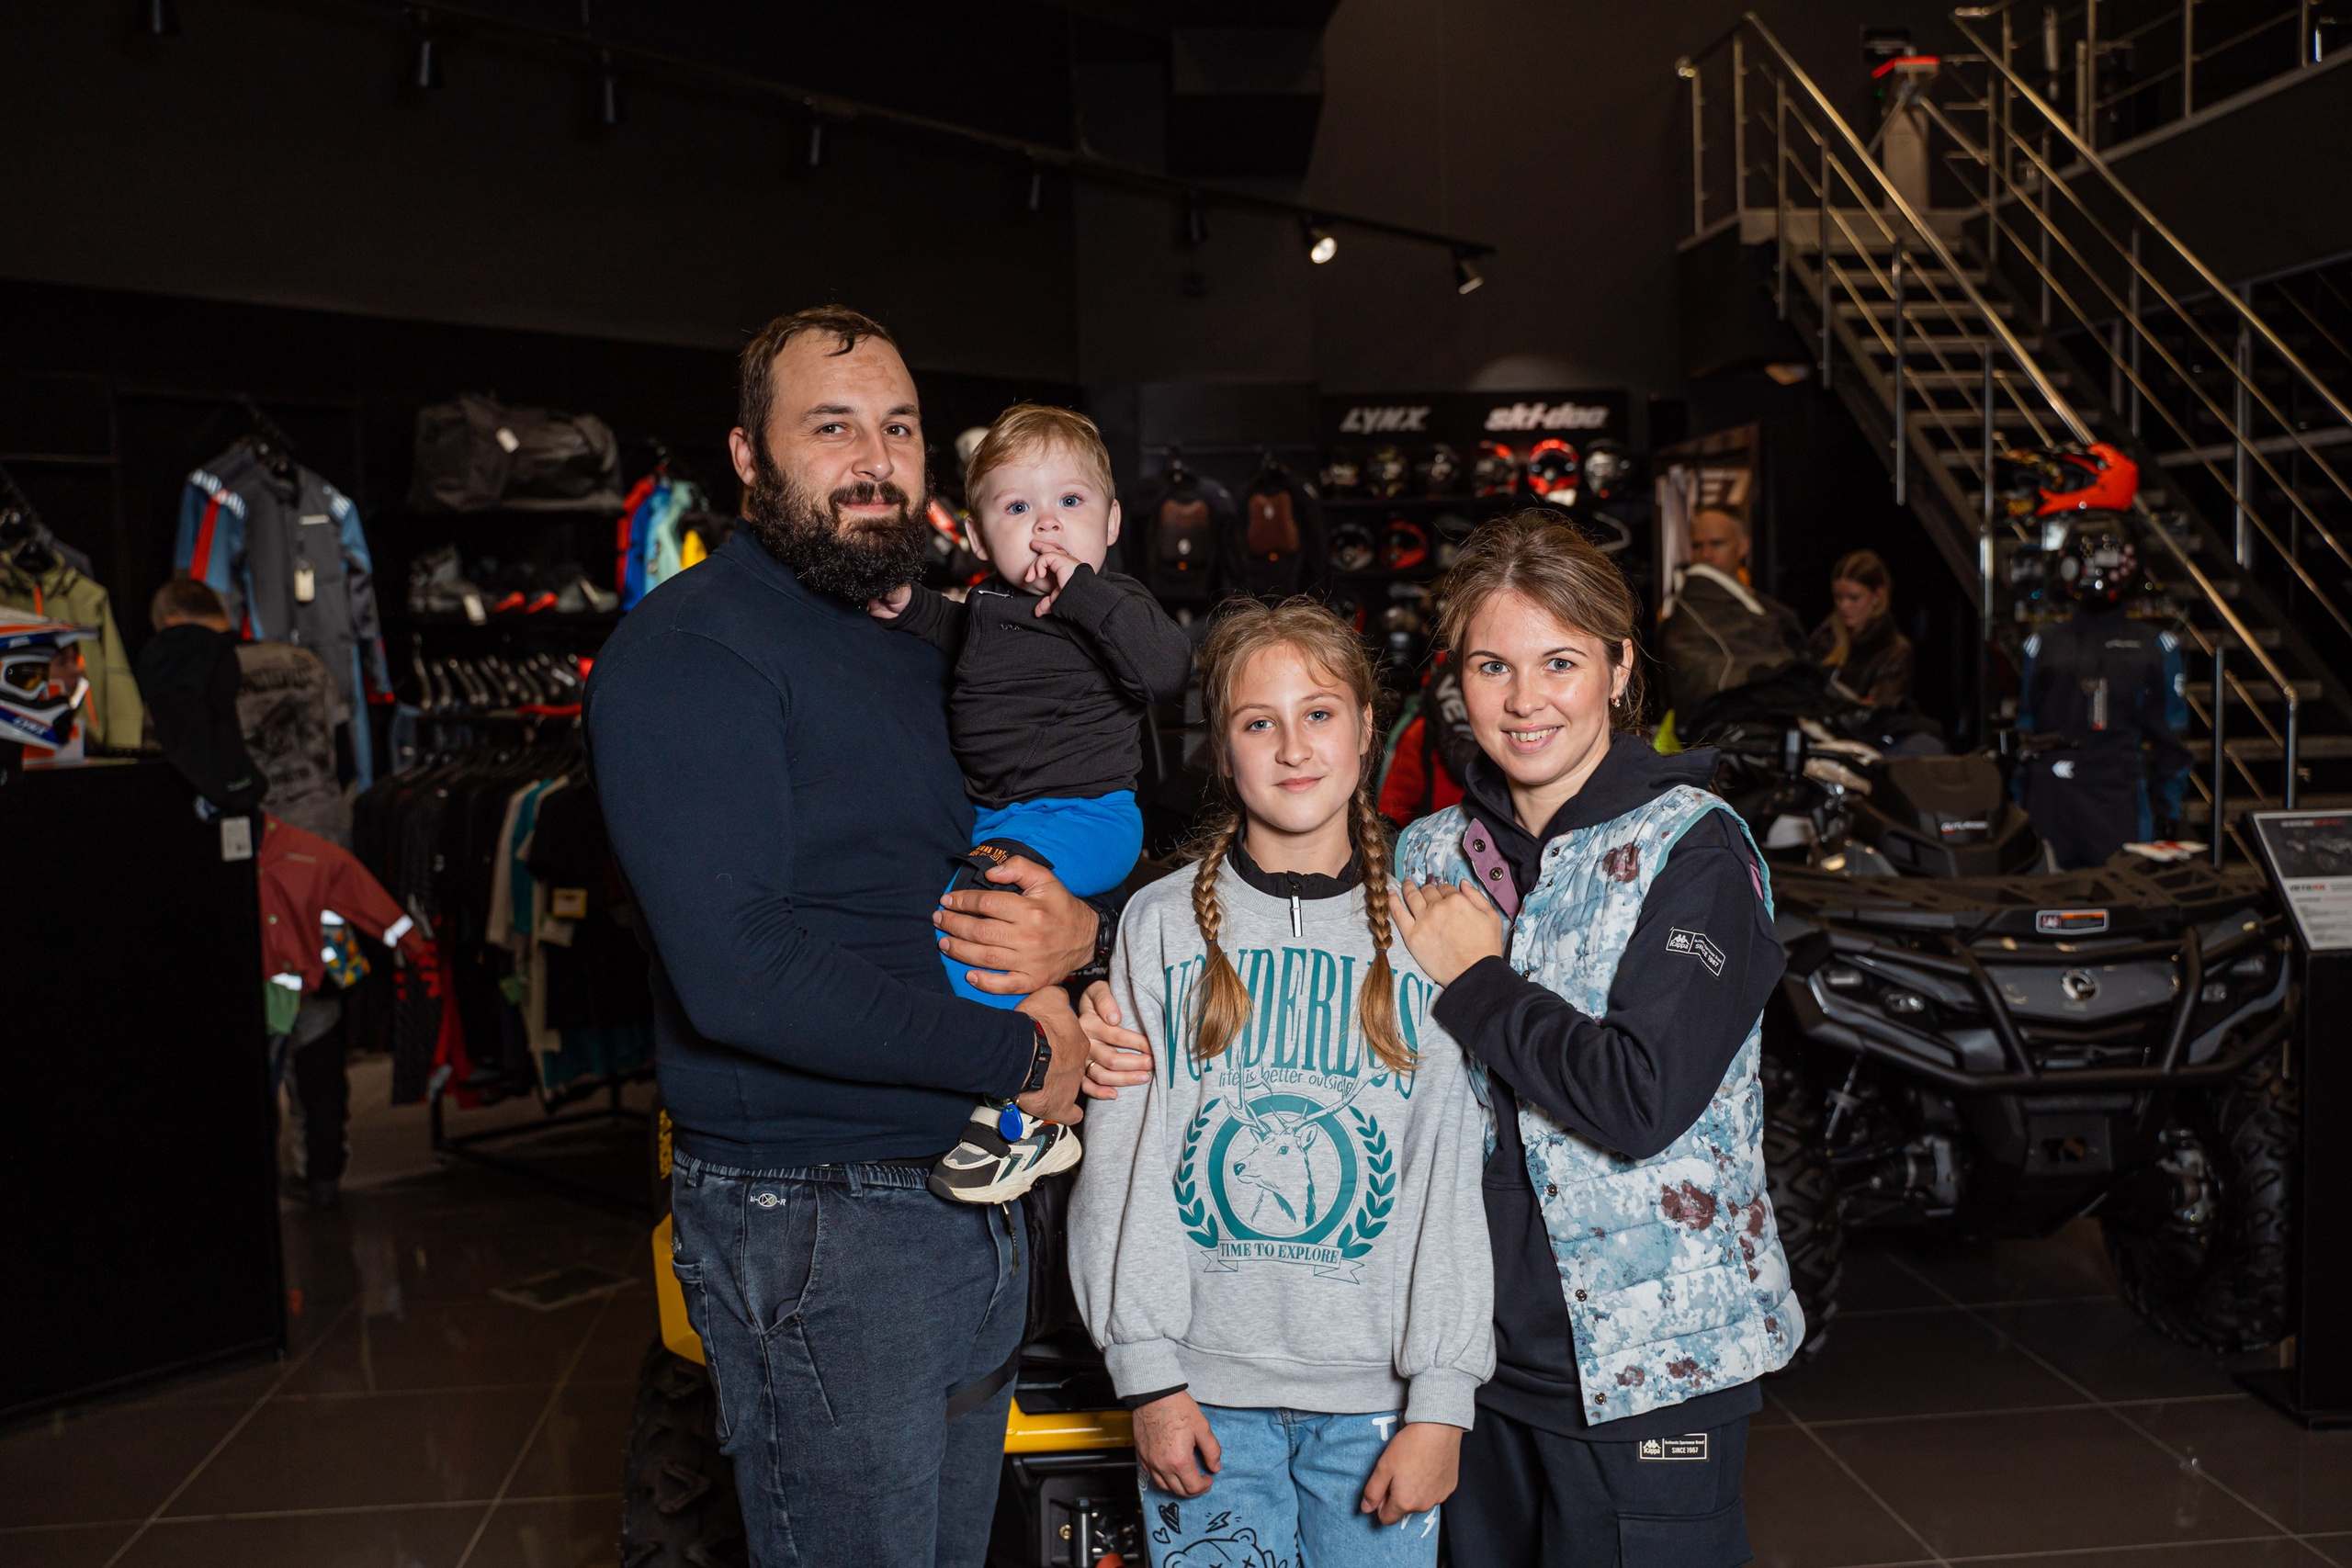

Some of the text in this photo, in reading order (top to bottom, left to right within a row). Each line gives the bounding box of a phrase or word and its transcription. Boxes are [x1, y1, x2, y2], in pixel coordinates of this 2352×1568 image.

[1218, 1066, 1355, 1093] life is better outside
[1220, 1243, 1340, 1264] TIME TO EXPLORE
